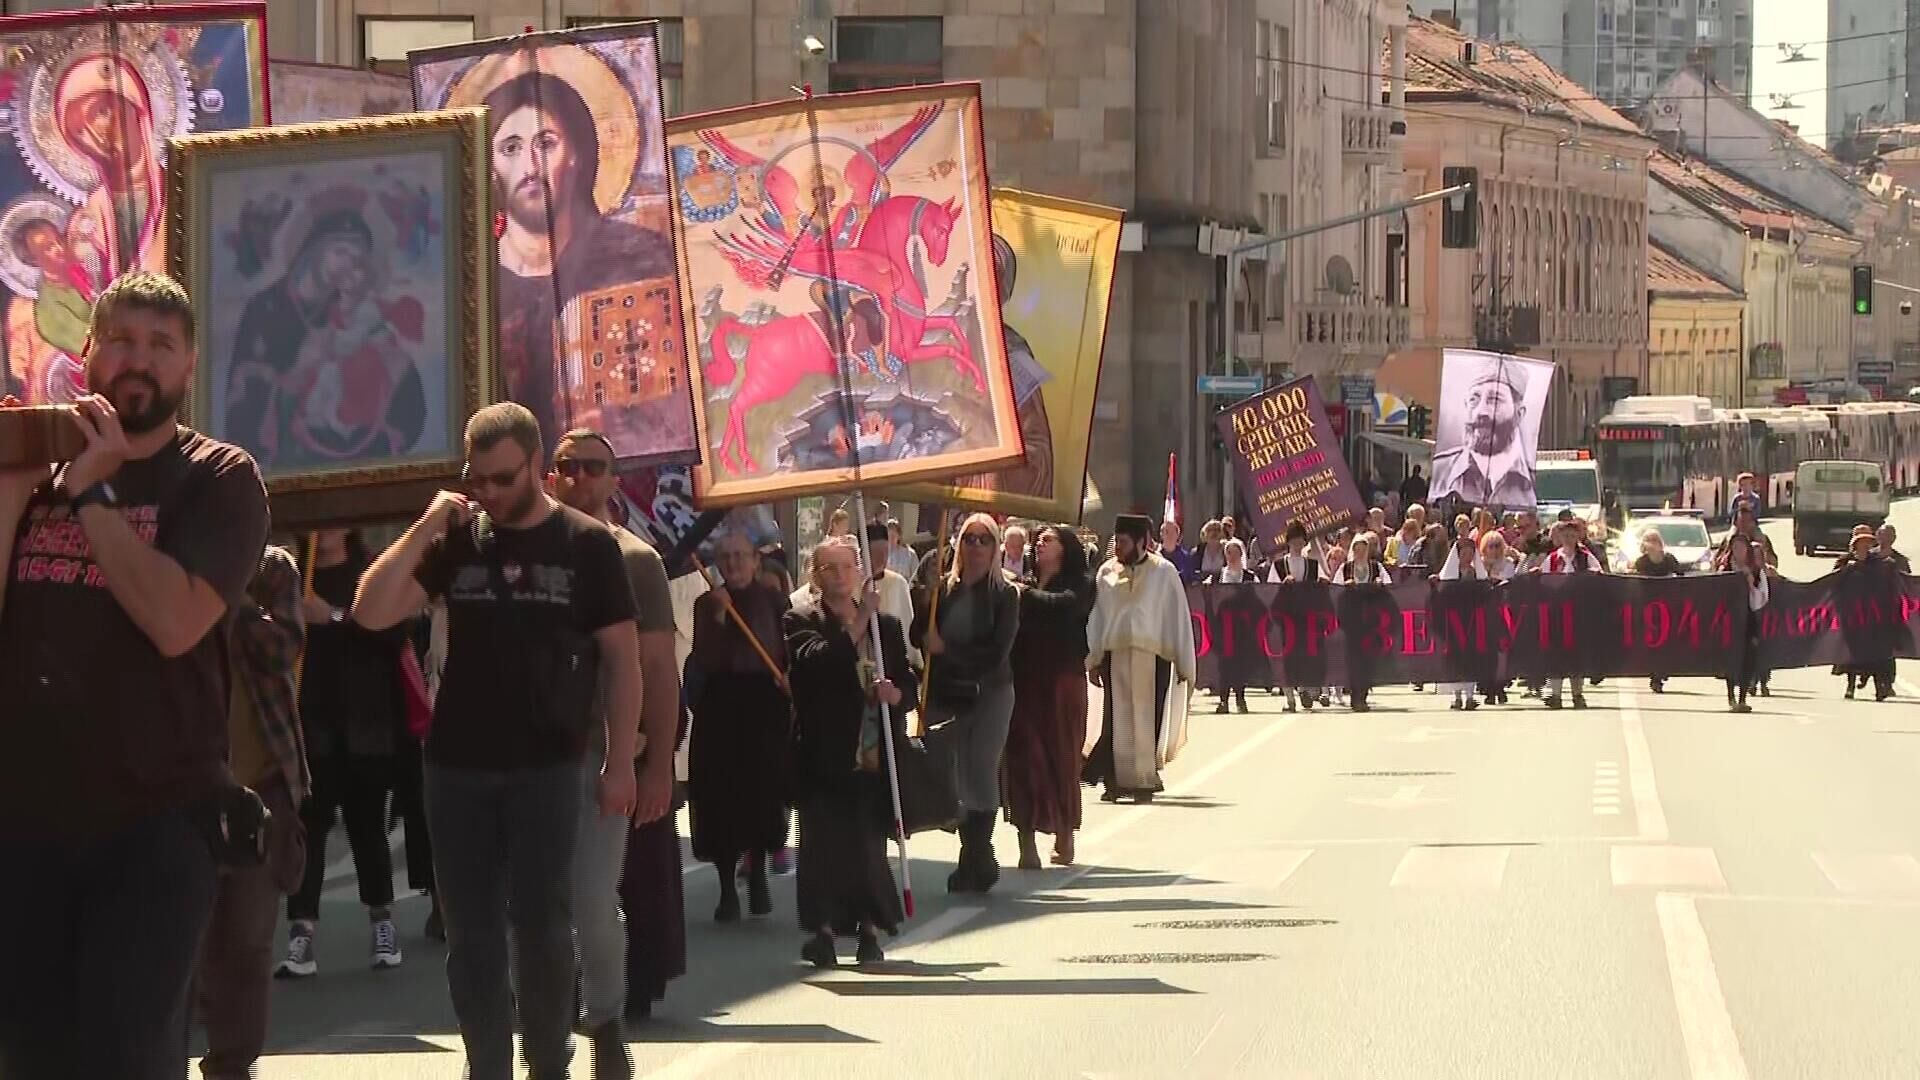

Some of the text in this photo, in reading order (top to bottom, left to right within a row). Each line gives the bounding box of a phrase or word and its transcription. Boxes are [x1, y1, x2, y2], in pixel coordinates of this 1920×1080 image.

[1232, 387, 1306, 435] 40.000
[1238, 409, 1315, 455] СРПСКИХ
[1246, 431, 1317, 471] ЖРТАВА
[1360, 601, 1576, 656] ЗЕМУН
[1618, 600, 1735, 650] 1944
